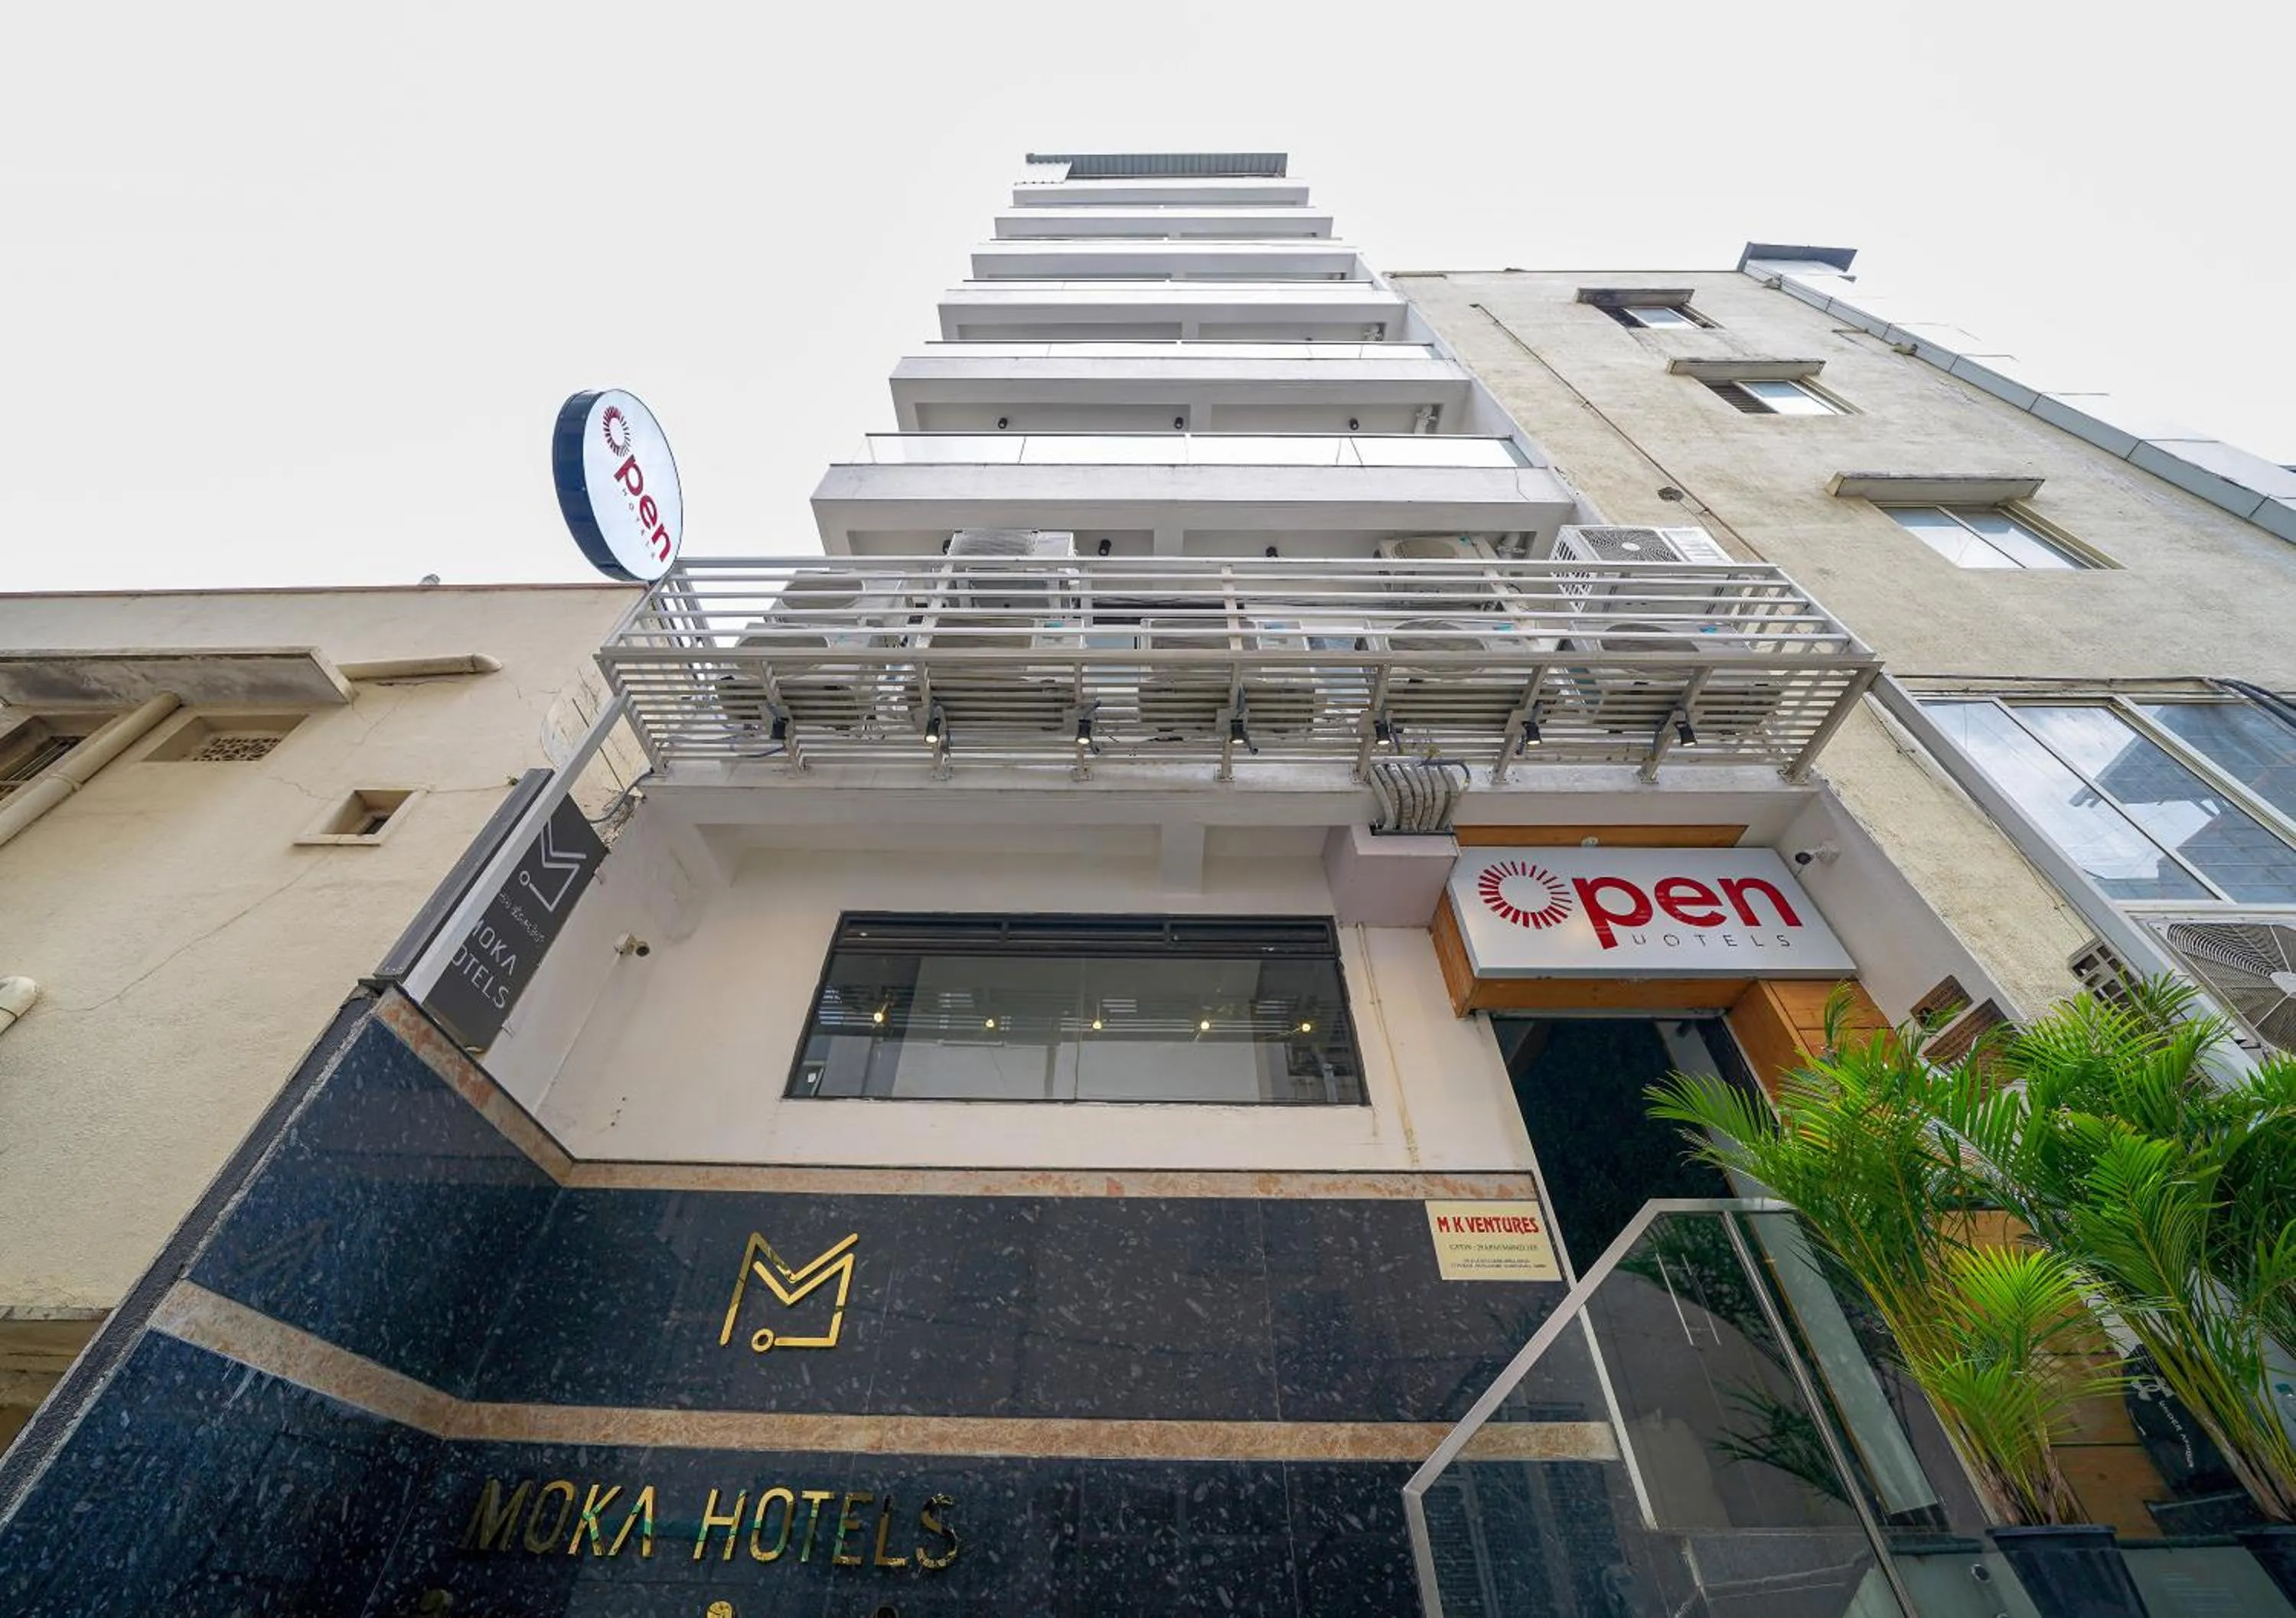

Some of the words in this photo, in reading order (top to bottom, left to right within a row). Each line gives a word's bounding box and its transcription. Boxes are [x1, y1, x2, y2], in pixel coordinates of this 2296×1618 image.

[452, 944, 509, 1009] OTELS
[1437, 1217, 1450, 1232] M
[1453, 1217, 1465, 1232] K
[1465, 1216, 1539, 1234] VENTURES
[458, 1478, 658, 1558] MOKA
[693, 1488, 958, 1570] HOTELS
